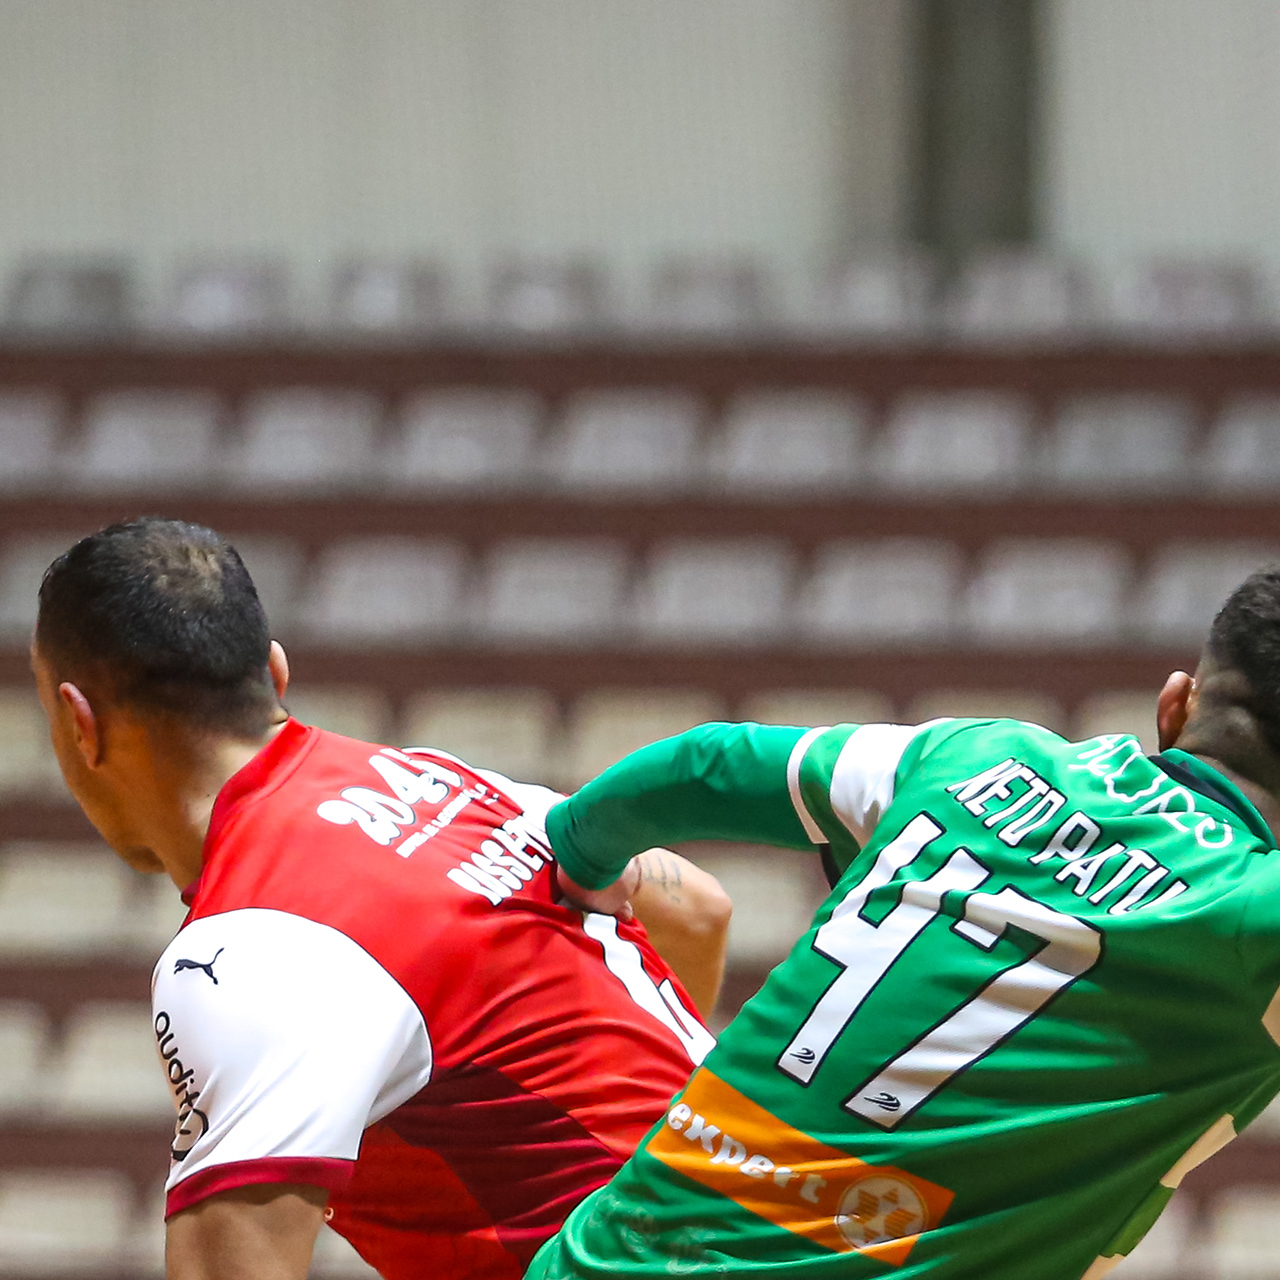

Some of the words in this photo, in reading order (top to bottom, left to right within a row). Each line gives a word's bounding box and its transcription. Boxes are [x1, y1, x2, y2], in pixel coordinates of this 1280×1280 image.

[945, 757, 1068, 848] NETO
[775, 811, 1105, 1133] 47
[667, 1102, 828, 1204] expert
